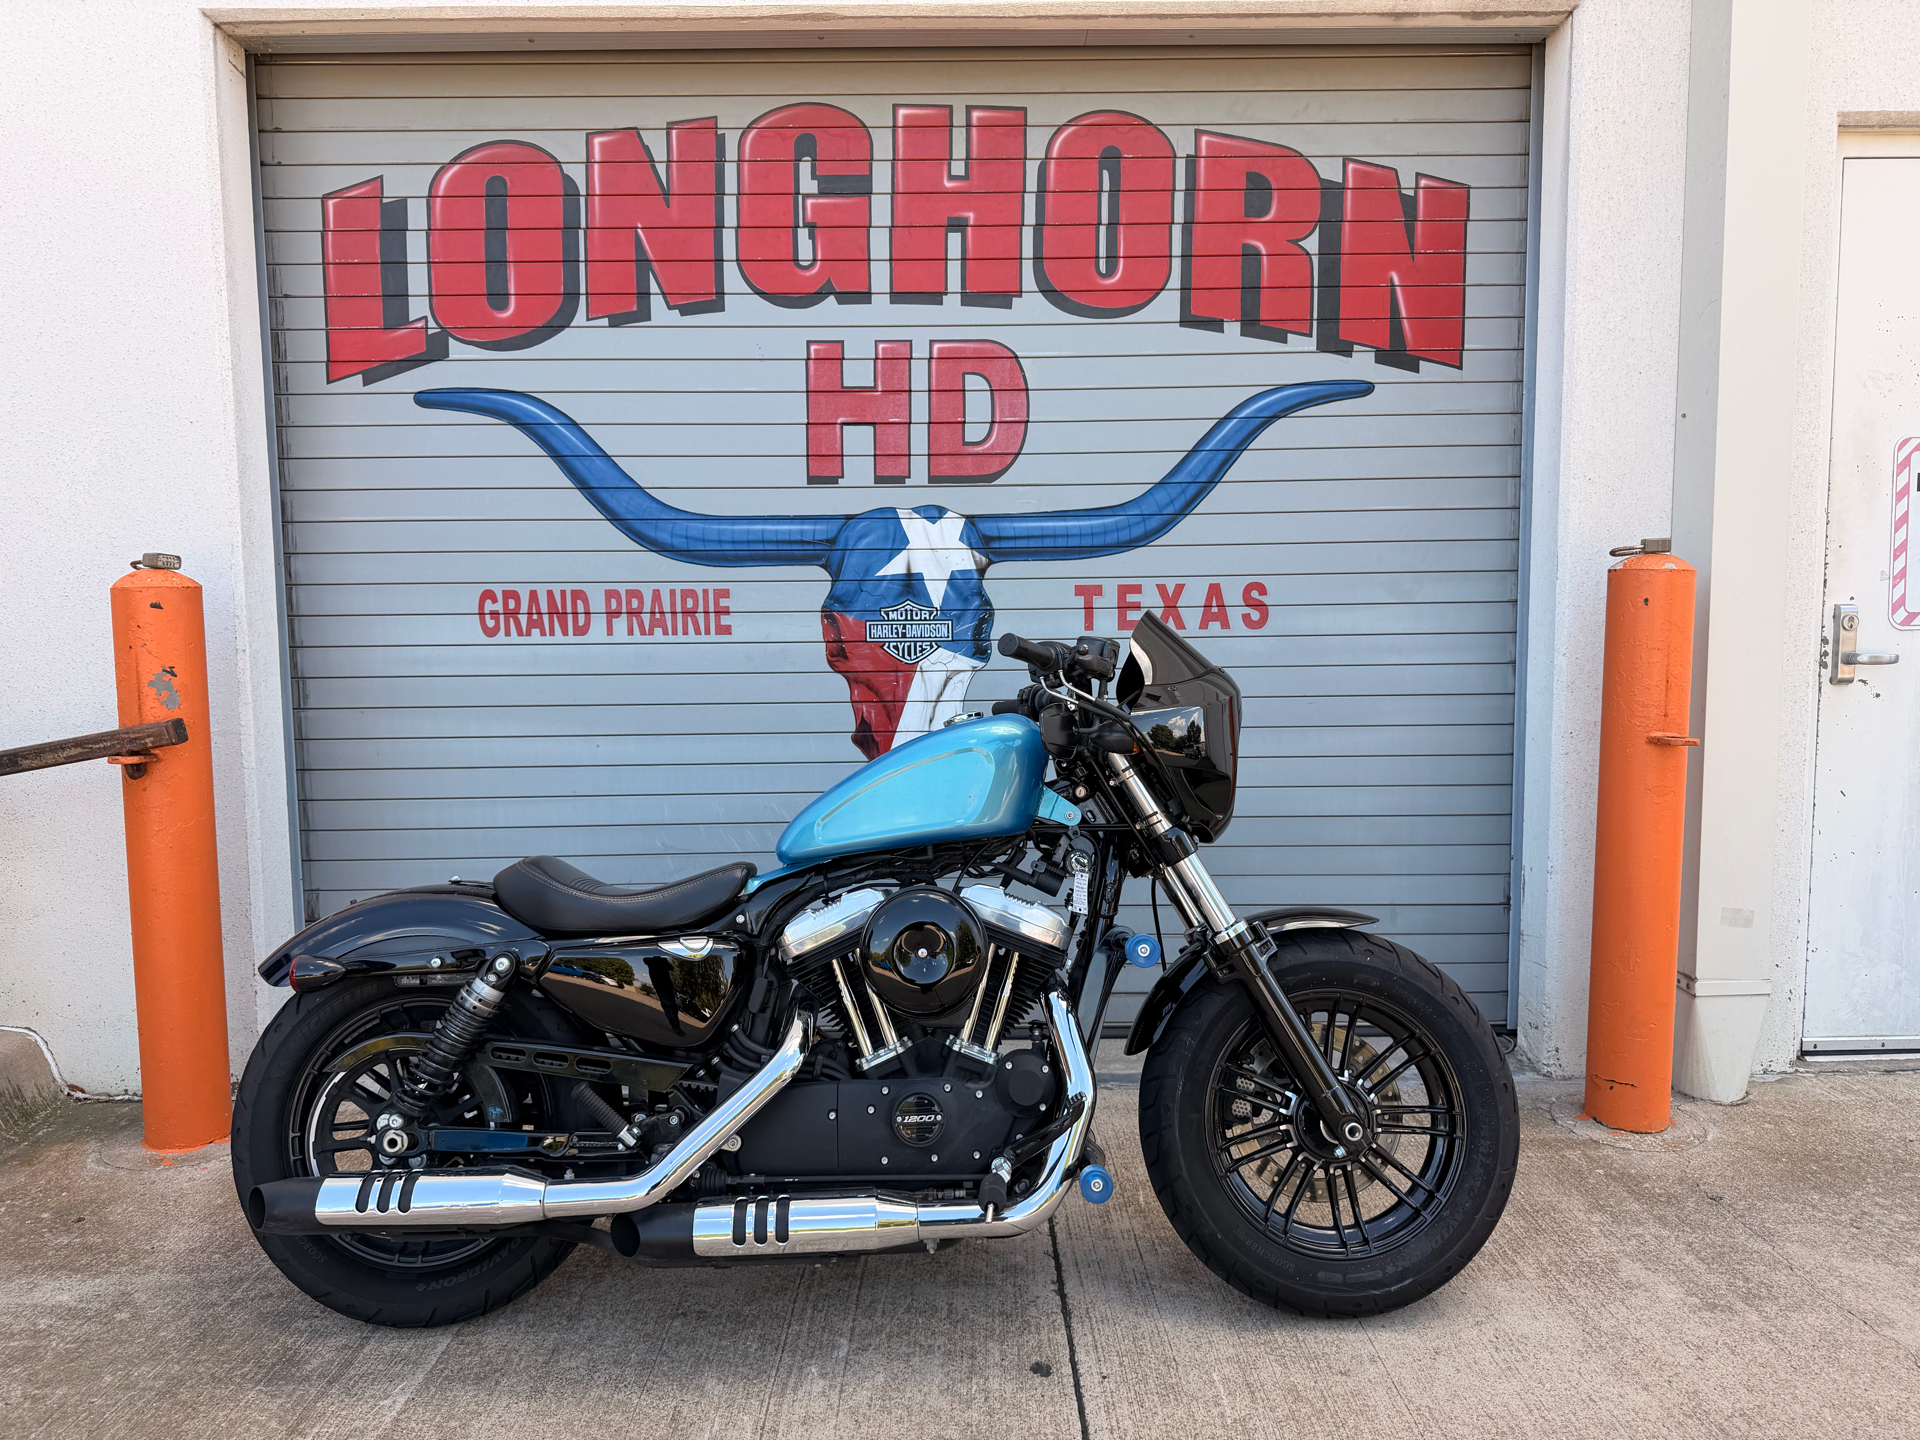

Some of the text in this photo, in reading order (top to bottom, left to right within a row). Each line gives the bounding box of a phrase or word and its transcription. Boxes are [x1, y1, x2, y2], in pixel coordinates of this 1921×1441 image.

[322, 102, 1469, 386] LONGHORN
[806, 339, 1029, 484] HD
[478, 588, 732, 638] GRAND PRAIRIE
[888, 604, 930, 620] MOTOR
[1074, 581, 1269, 631] TEXAS
[870, 623, 948, 639] HARLEY-DAVIDSON
[889, 642, 931, 660] CYCLES
[288, 982, 379, 1054] MICHELIN
[903, 1114, 935, 1123] 1200
[1246, 1238, 1296, 1272] SCORCHER
